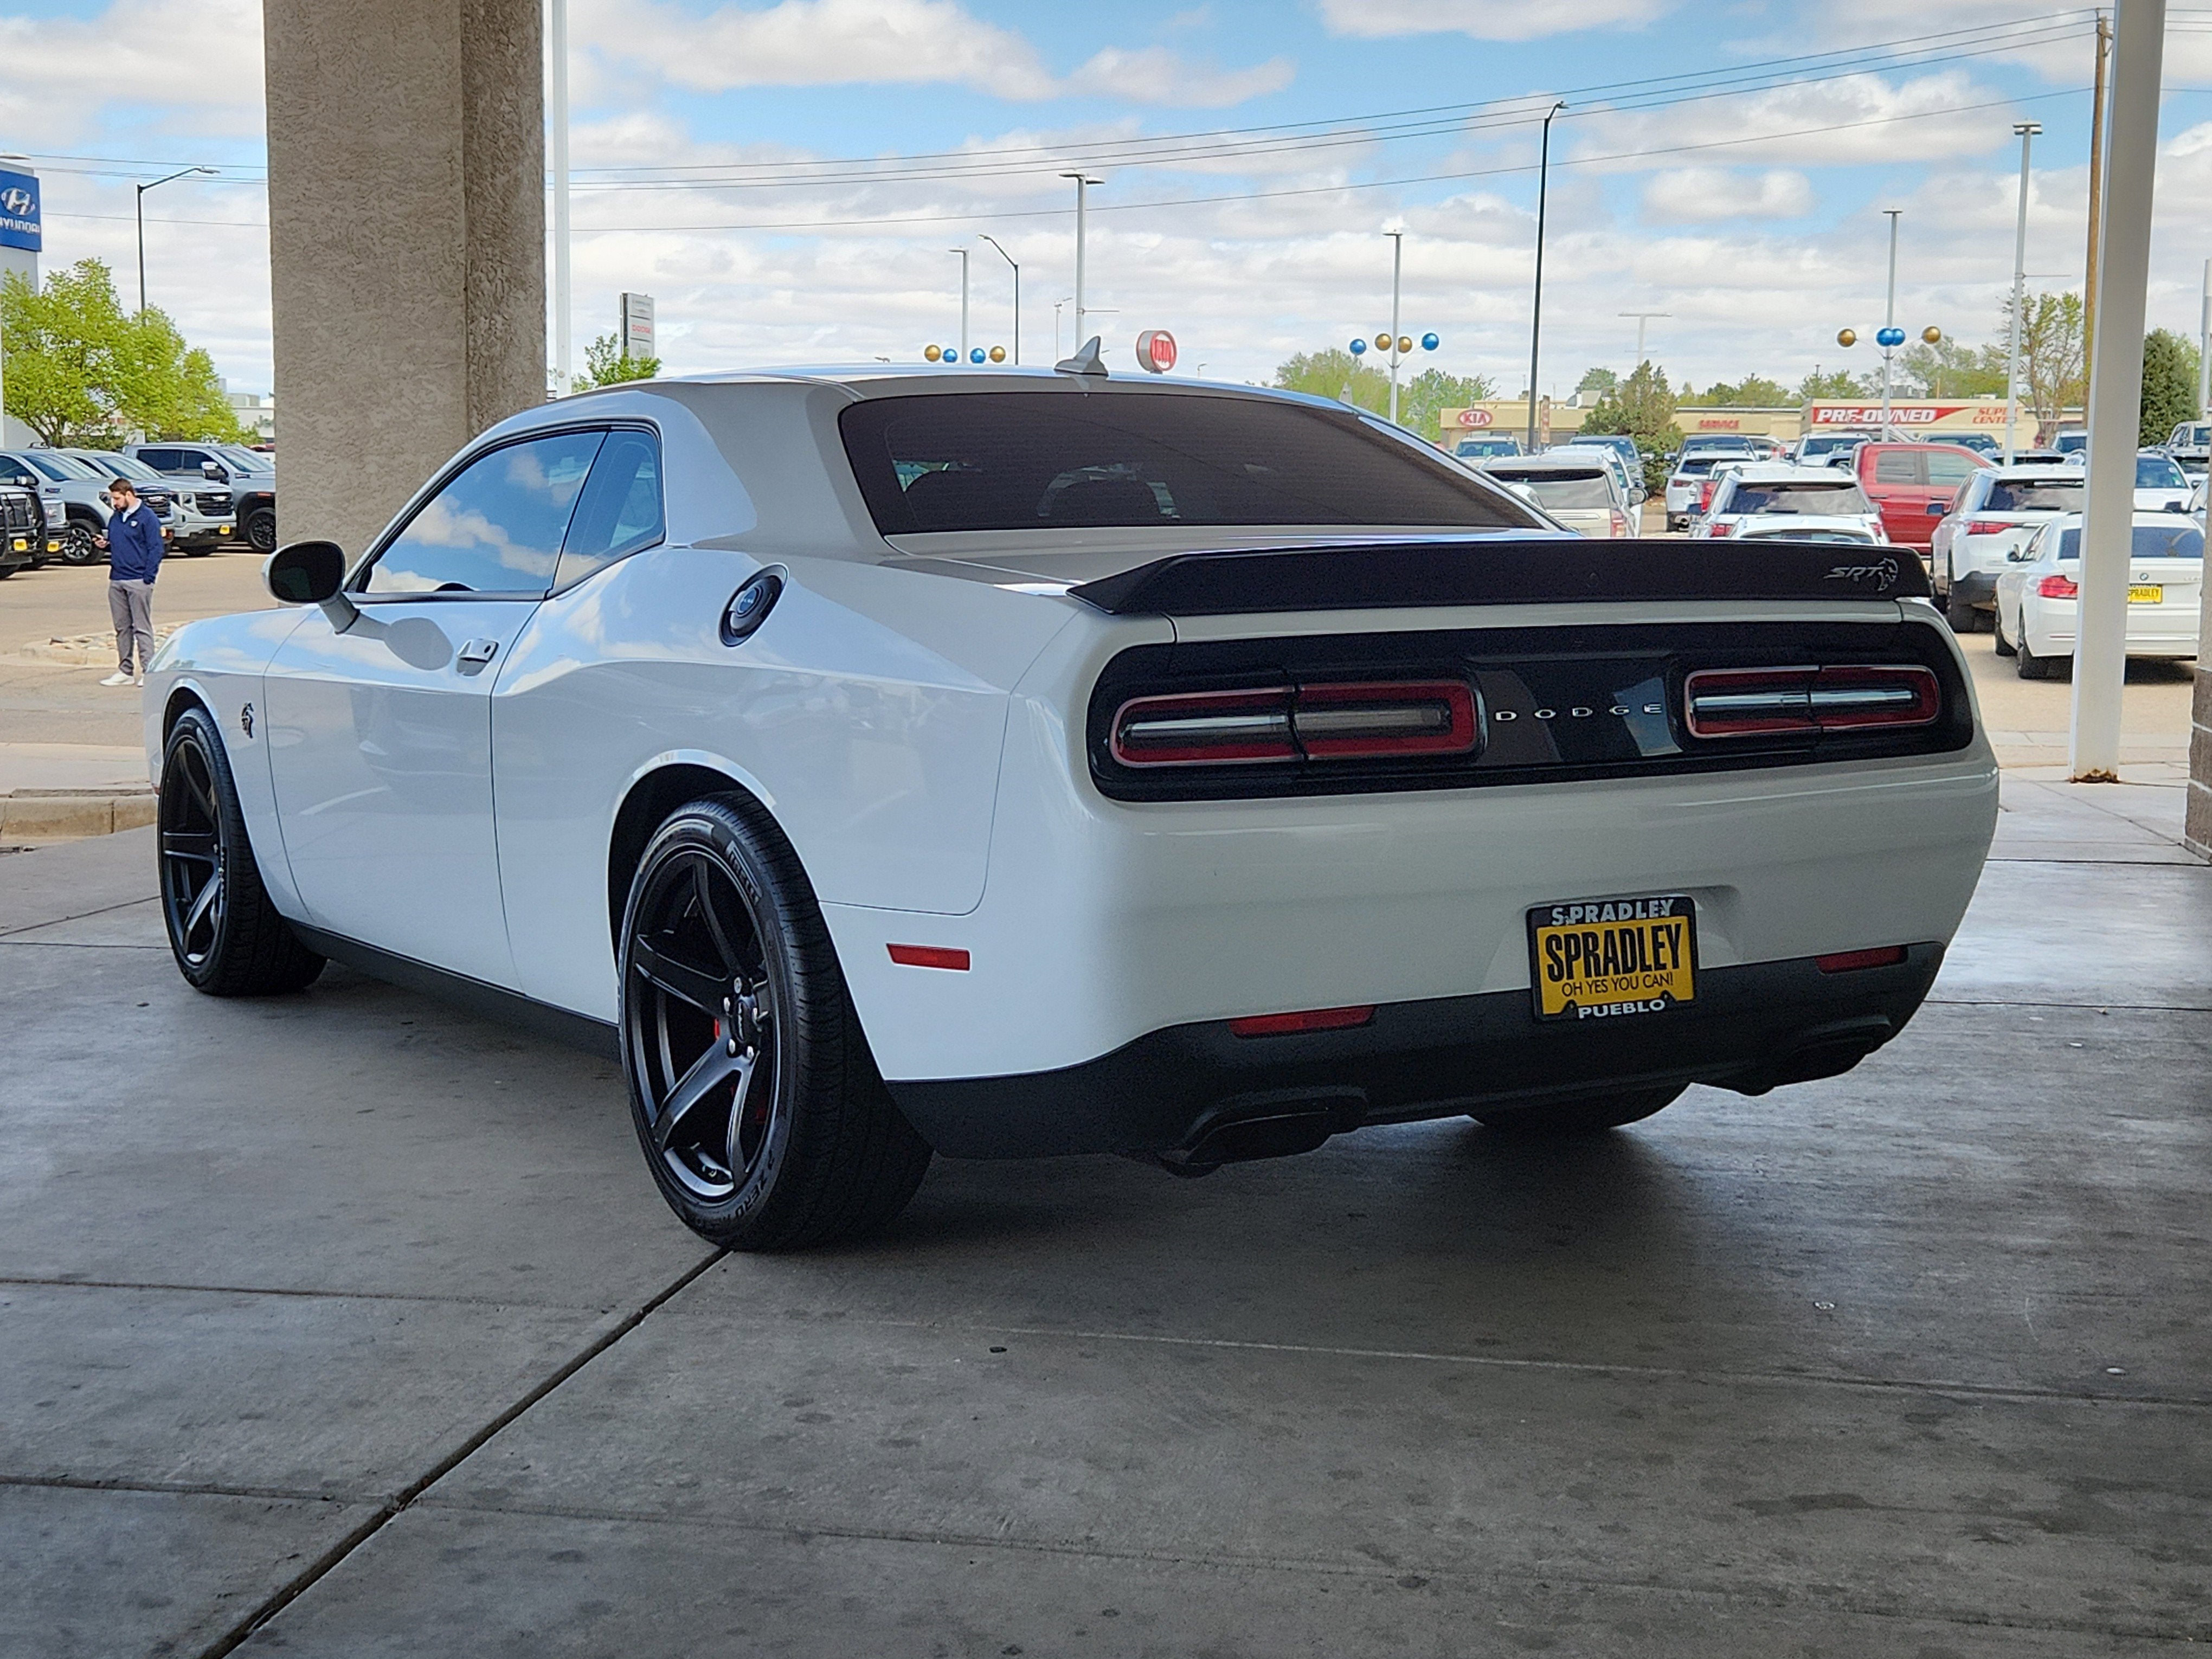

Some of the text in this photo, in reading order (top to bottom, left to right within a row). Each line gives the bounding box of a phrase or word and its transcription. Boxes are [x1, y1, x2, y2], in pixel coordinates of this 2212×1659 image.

[1463, 413, 1487, 424] KIA
[1816, 408, 1937, 423] PRE-OWNED
[1978, 407, 2018, 415] SUPE
[1972, 416, 2008, 425] CENTE
[1823, 567, 1885, 582] SRT
[1495, 704, 1663, 722] DODGE
[1551, 898, 1674, 926] SPRADLEY
[1545, 923, 1682, 982] SPRADLEY
[1561, 971, 1674, 997] OH YES YOU CAN!
[1578, 999, 1666, 1019] PUEBLO
